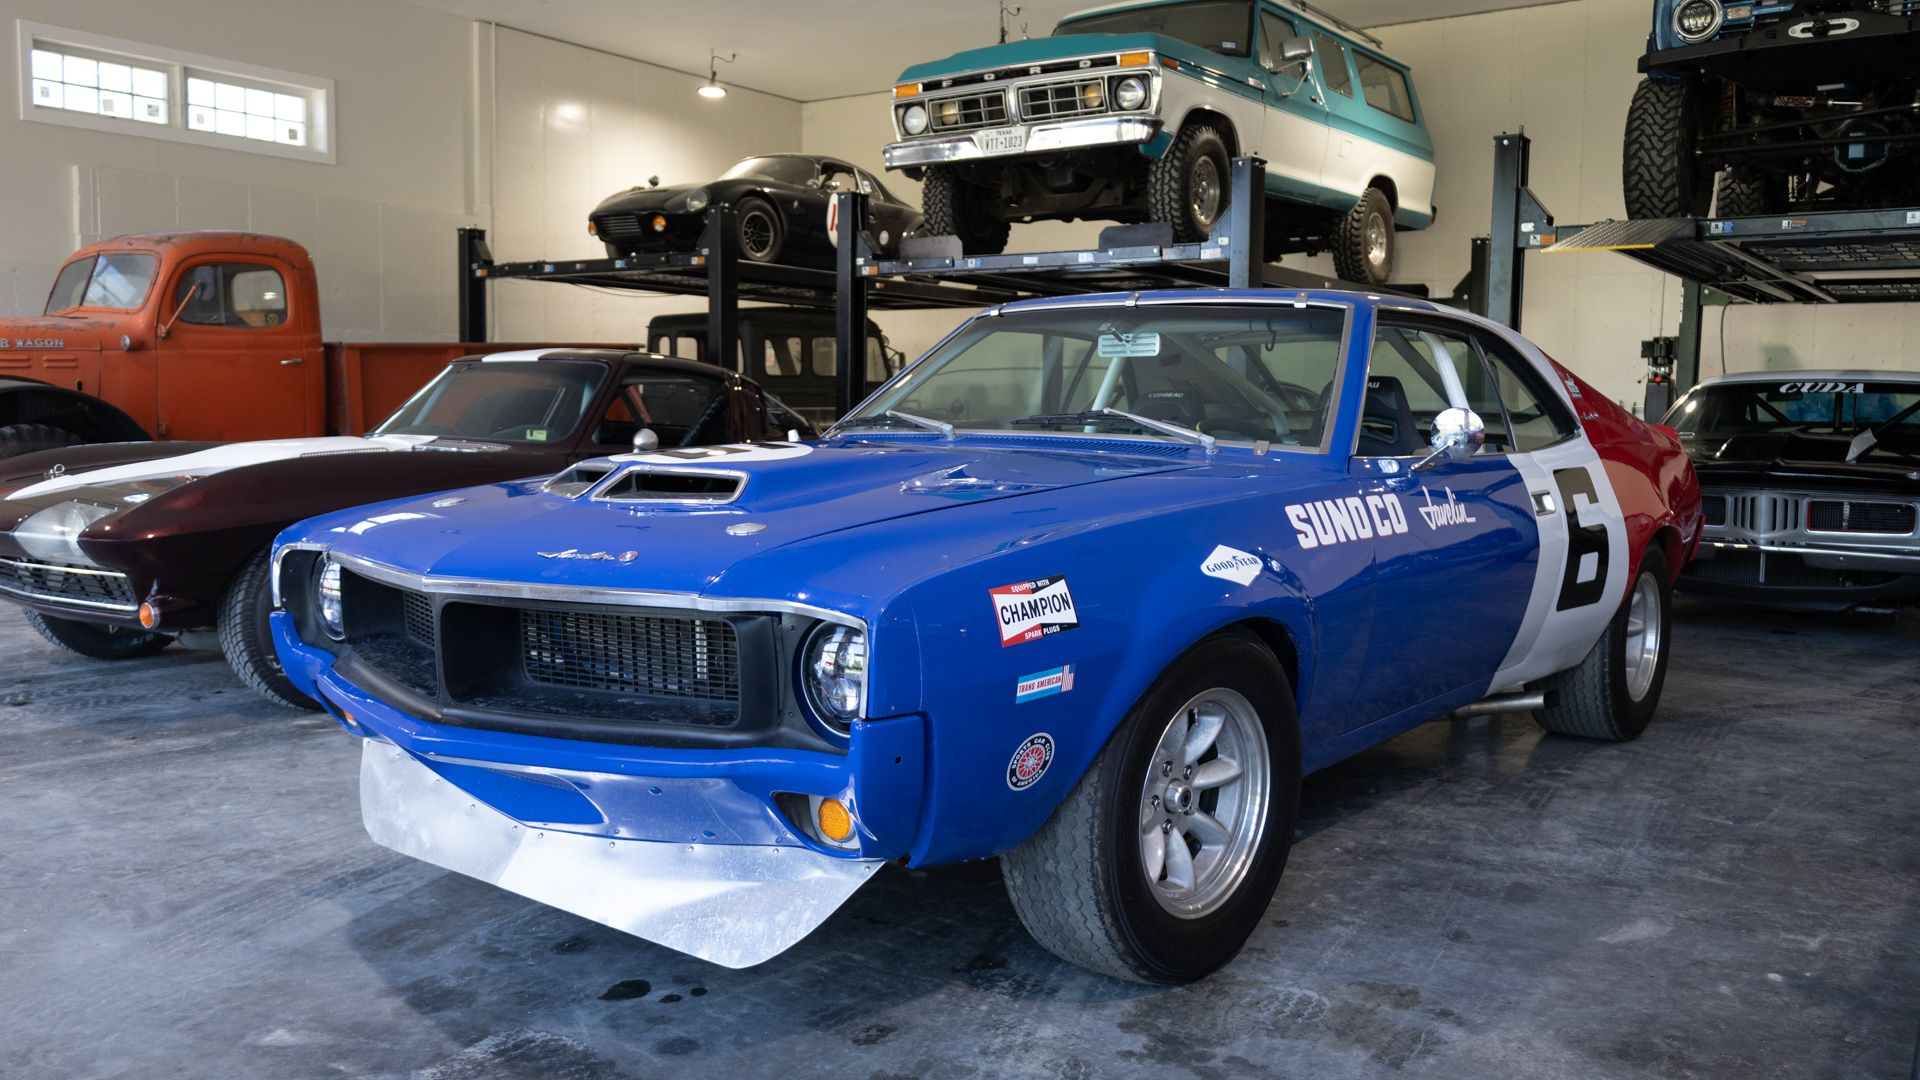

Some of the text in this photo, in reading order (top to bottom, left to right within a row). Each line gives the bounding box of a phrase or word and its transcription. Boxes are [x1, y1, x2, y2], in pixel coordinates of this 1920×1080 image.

[942, 60, 1092, 88] FORD
[15, 338, 65, 348] WAGON
[1779, 382, 1865, 394] CUDA
[1285, 485, 1476, 549] SUNOCO Javelin
[1553, 466, 1610, 612] 6
[1011, 579, 1050, 593] EQUIPPED WITH
[1000, 592, 1071, 625] CHAMPION
[1024, 624, 1060, 640] SPARK PLUGS
[1018, 682, 1036, 694] TRANS
[1036, 675, 1062, 689] AMERICAN
[1011, 741, 1031, 769] SPORTS
[1033, 737, 1046, 745] CAR
[1016, 769, 1043, 786] AMERICA
